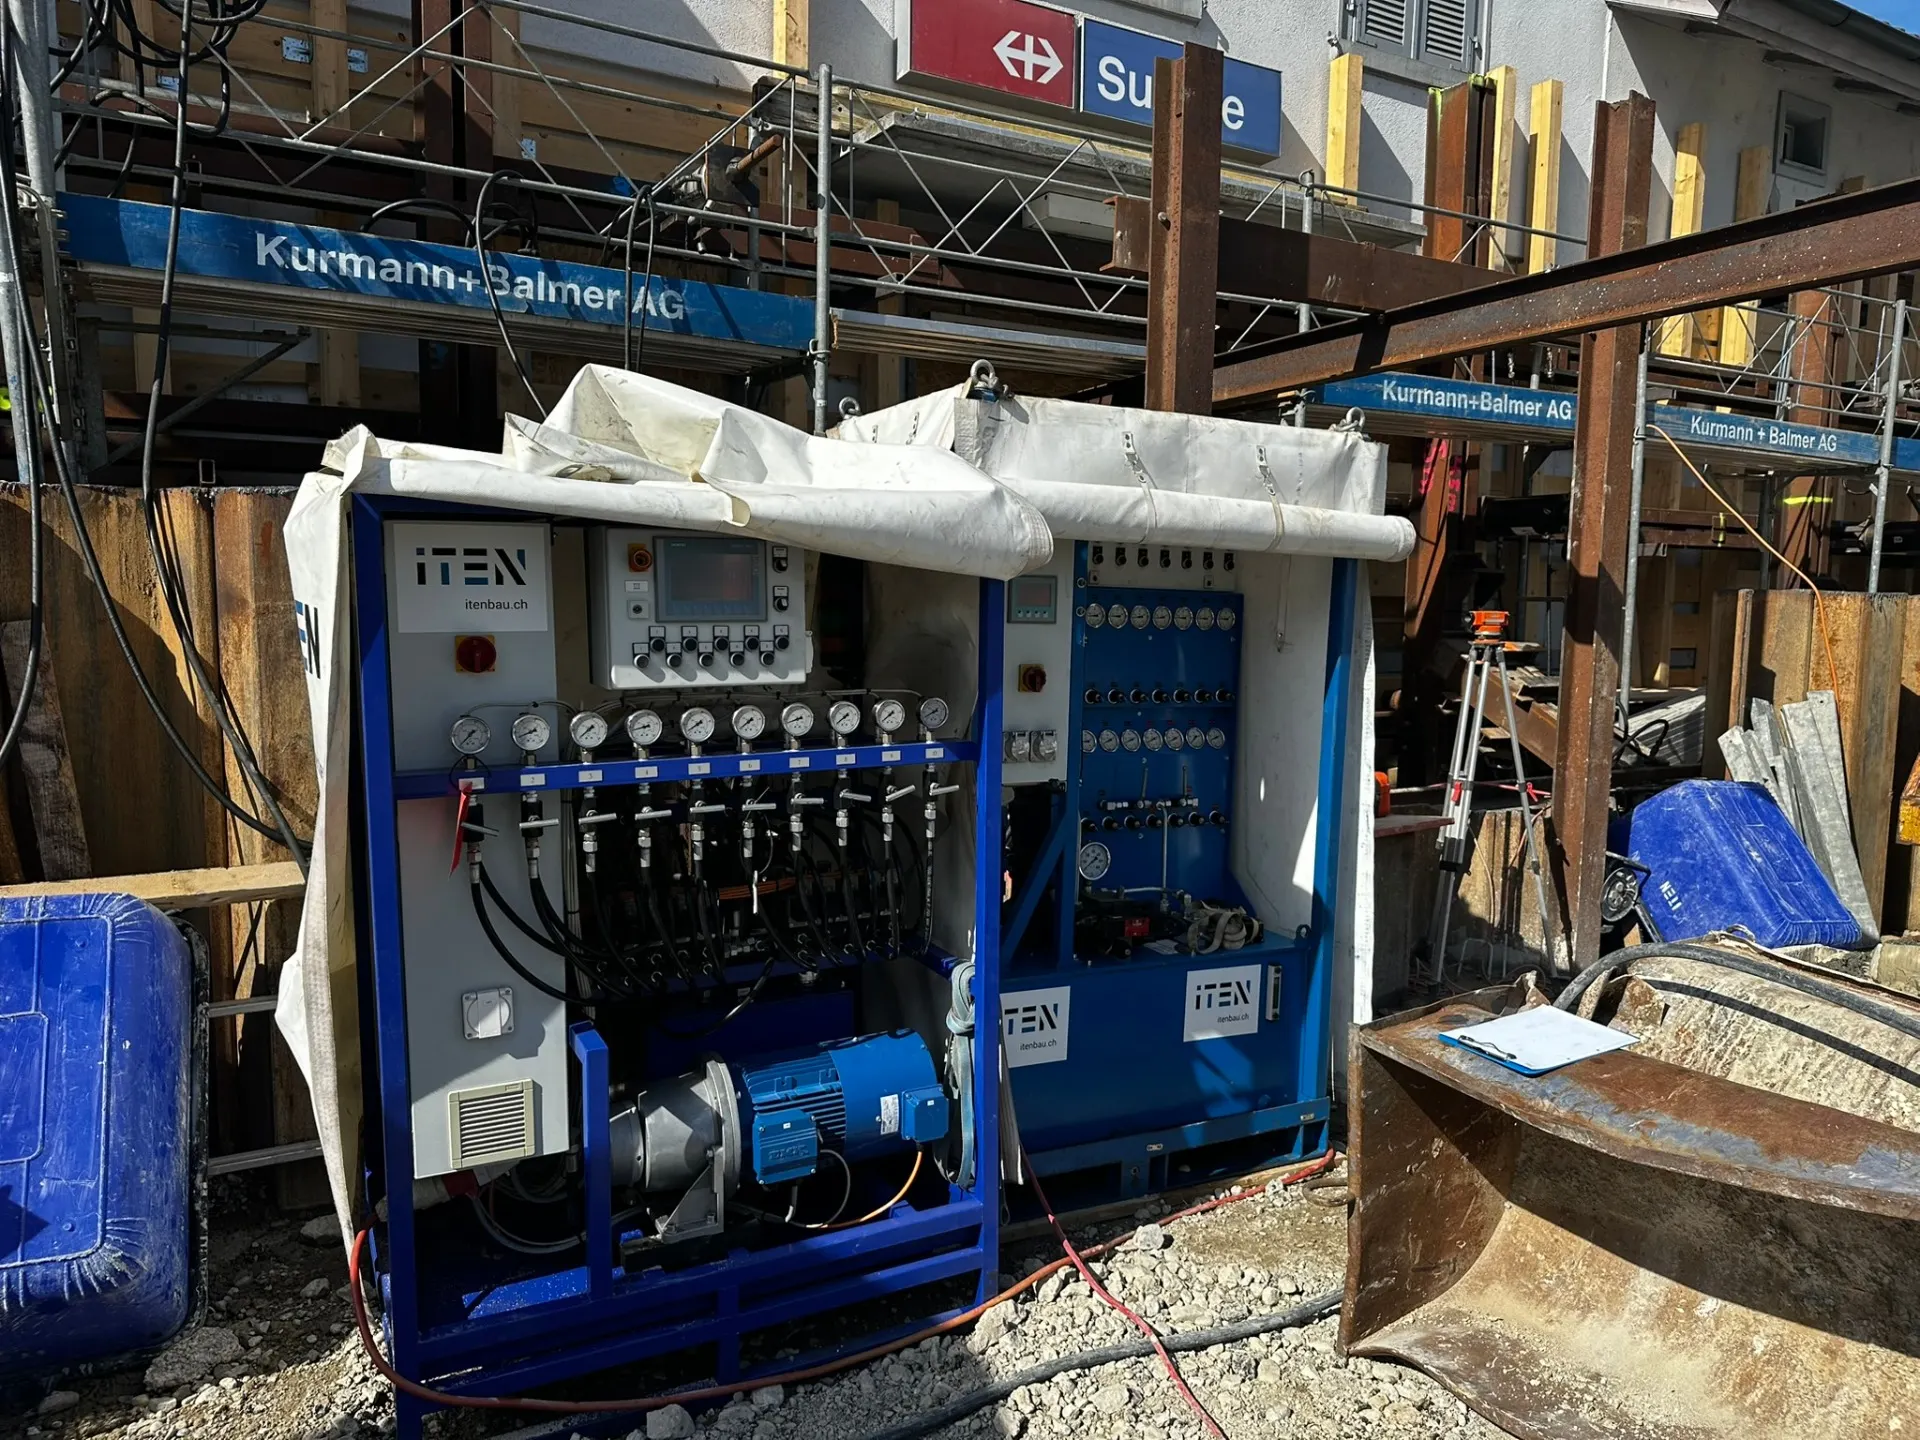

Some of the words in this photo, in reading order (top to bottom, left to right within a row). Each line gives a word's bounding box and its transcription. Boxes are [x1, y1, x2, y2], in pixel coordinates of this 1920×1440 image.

[1097, 55, 1245, 131] Sue
[632, 285, 685, 320] AG
[1382, 379, 1542, 417] Kurmann+Balmer
[1546, 399, 1572, 420] AG
[1690, 415, 1754, 442] Kurmann
[1757, 427, 1766, 441] +
[1769, 426, 1816, 448] Balmer
[1817, 433, 1838, 452] AG
[465, 598, 528, 610] itenbau.ch
[1004, 1003, 1059, 1035] TEN
[1217, 1012, 1250, 1024] itenbau.ch
[1020, 1038, 1057, 1052] itenbau.ch
